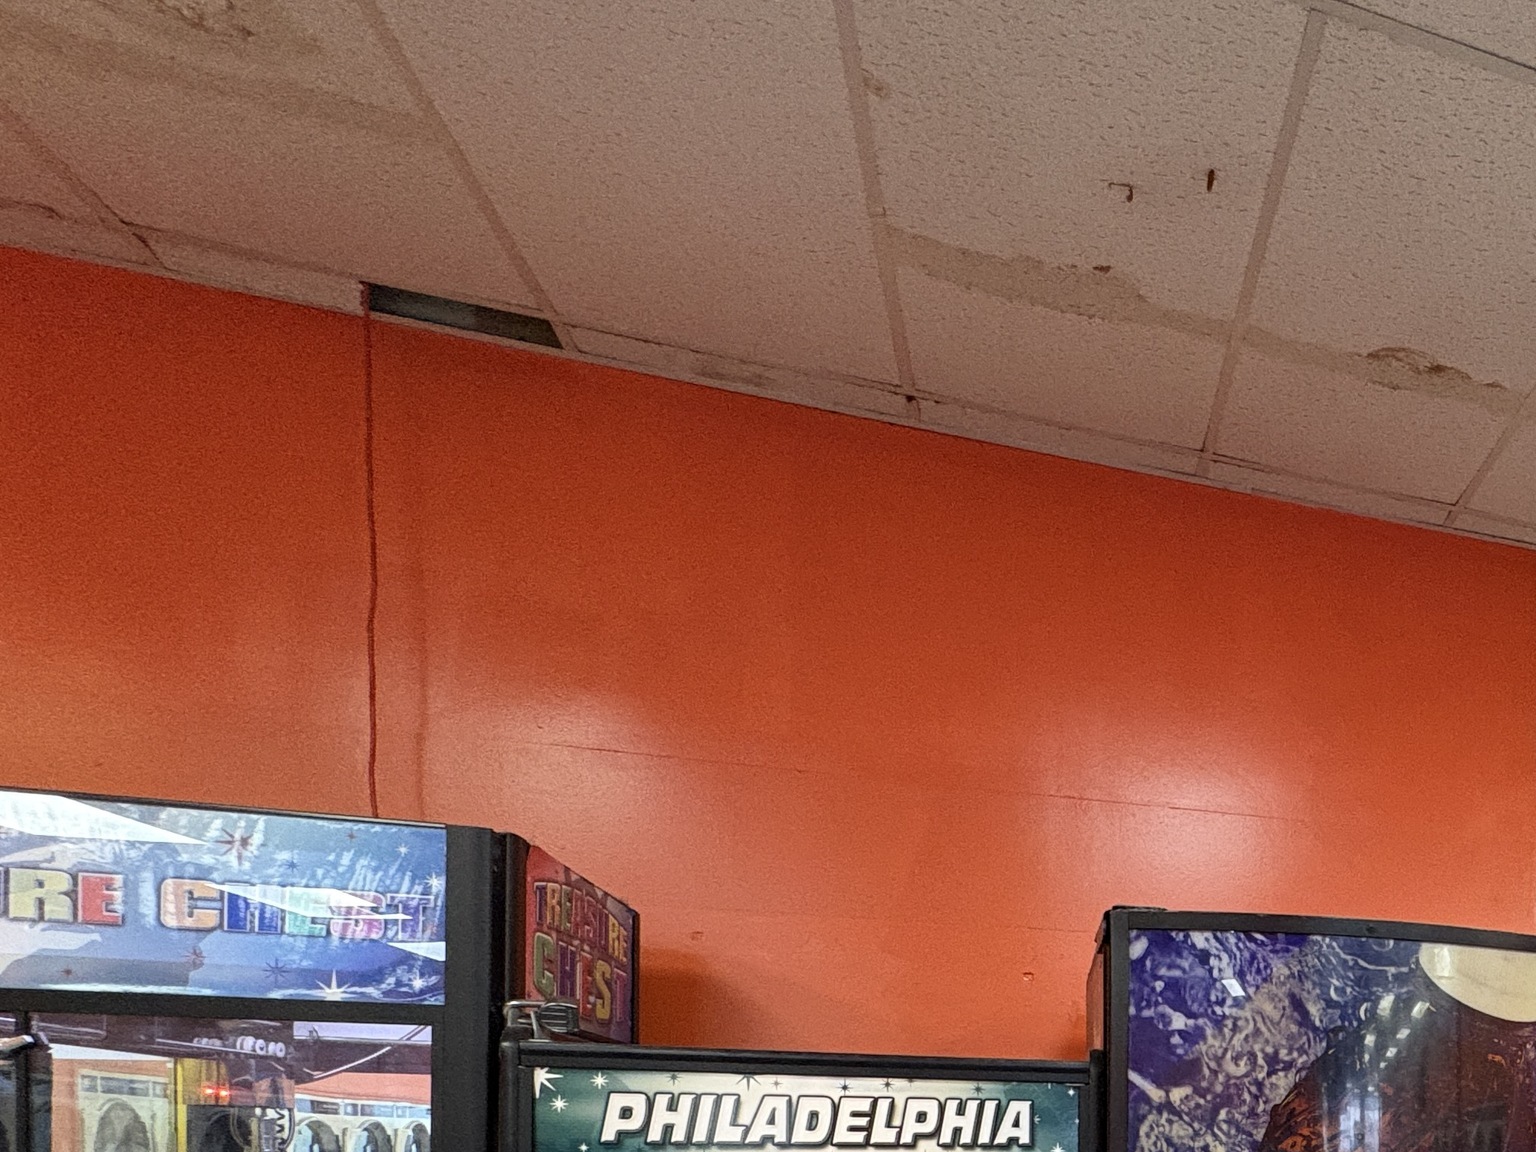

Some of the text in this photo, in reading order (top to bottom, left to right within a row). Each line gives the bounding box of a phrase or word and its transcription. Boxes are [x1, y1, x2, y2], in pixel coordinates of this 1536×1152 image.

[0, 867, 434, 941] RE CHEST
[533, 882, 628, 966] TREASURE
[533, 932, 628, 1023] CHEST
[602, 1092, 1034, 1147] PHILADELPHIA
